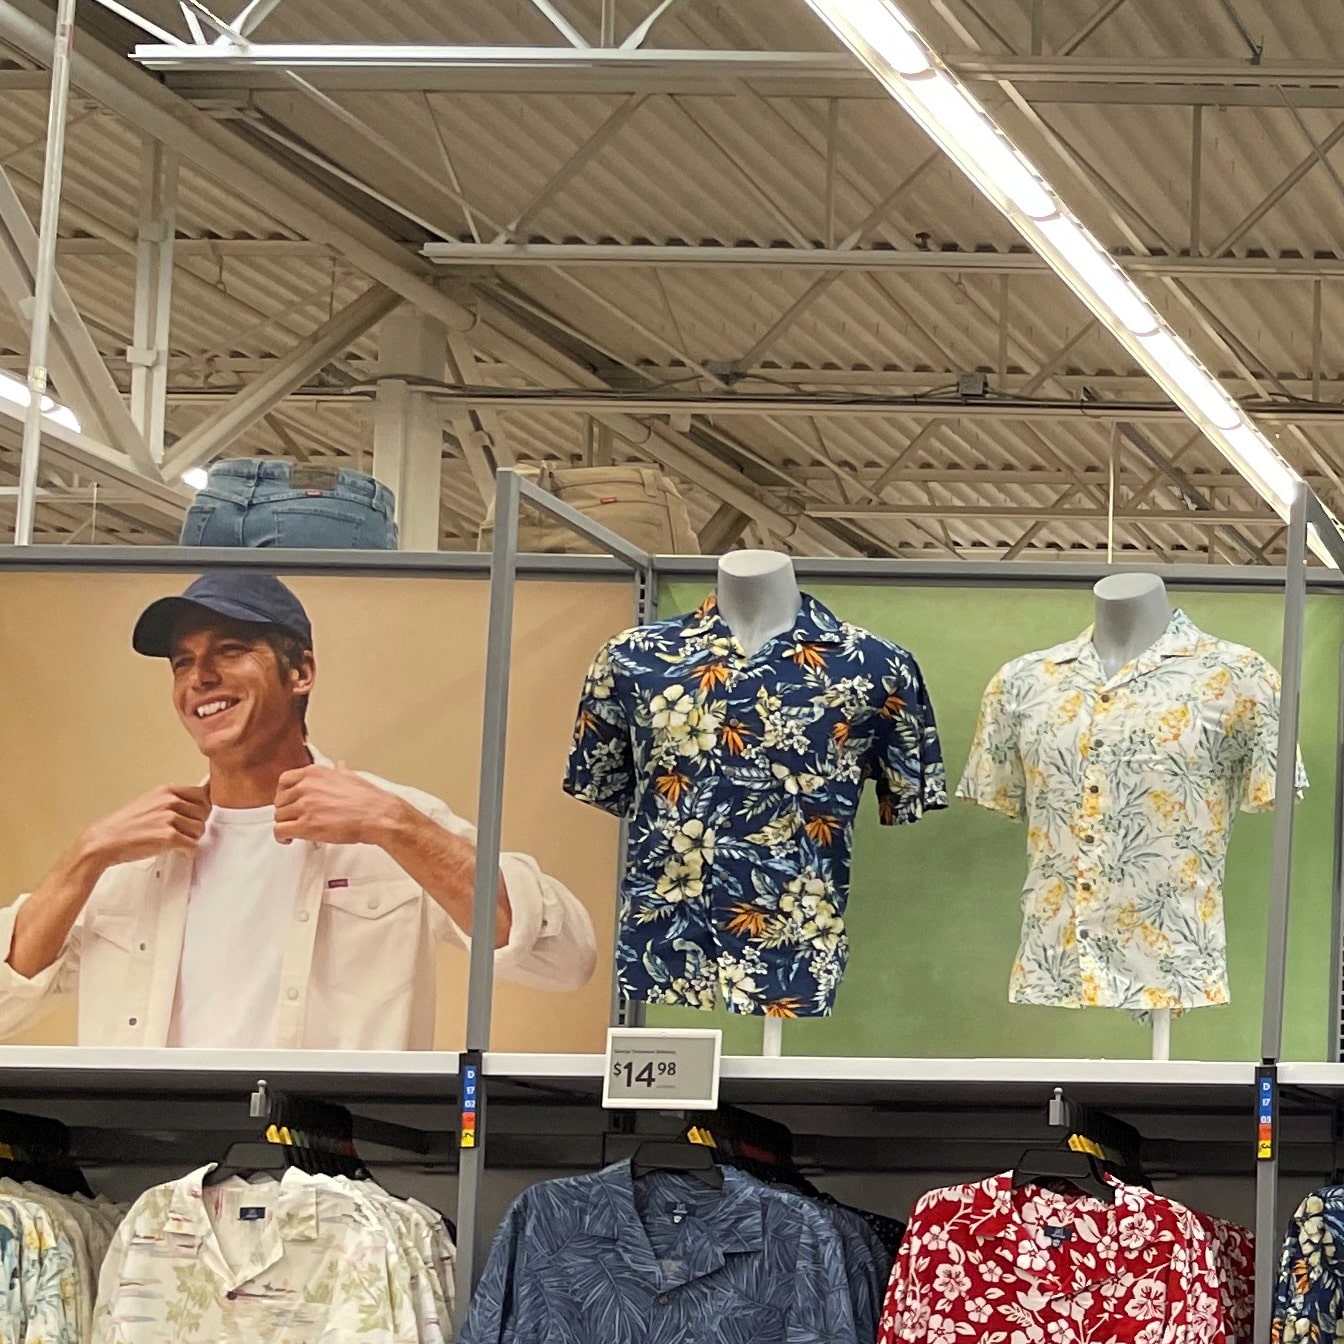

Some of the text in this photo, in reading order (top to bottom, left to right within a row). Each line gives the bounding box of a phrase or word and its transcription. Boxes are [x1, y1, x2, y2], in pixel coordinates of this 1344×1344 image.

[467, 1070, 476, 1079] D
[466, 1086, 476, 1095] 17
[1262, 1082, 1271, 1091] D
[1262, 1098, 1271, 1106] 17
